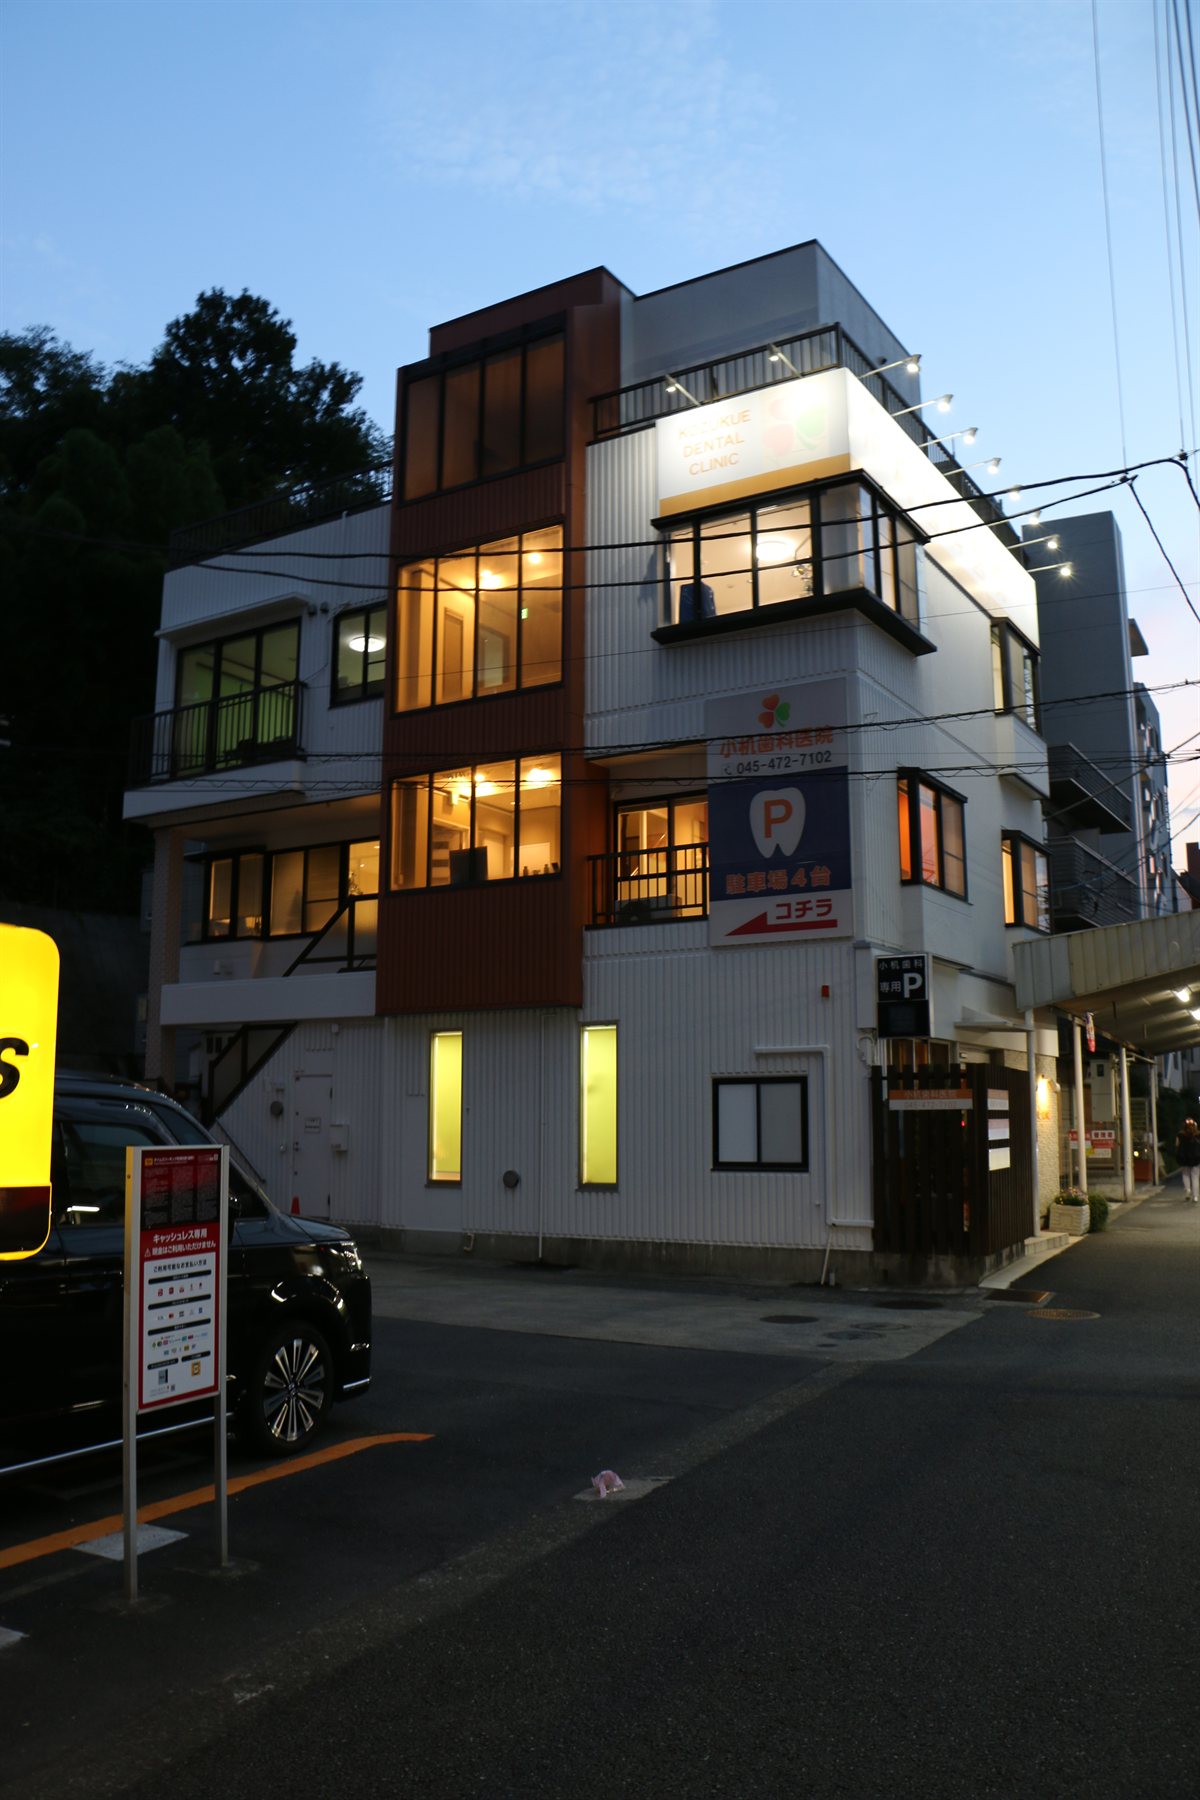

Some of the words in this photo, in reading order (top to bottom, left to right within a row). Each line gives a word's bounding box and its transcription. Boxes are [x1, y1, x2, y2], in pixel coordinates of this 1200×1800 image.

[683, 432, 745, 458] DENTAL
[689, 452, 739, 475] CLINIC
[720, 725, 833, 758] 小机歯科医院
[736, 750, 832, 775] 045-472-7102
[764, 799, 793, 838] P
[725, 865, 831, 895] 駐車場4台
[775, 898, 832, 920] コチラ
[903, 973, 923, 998] P
